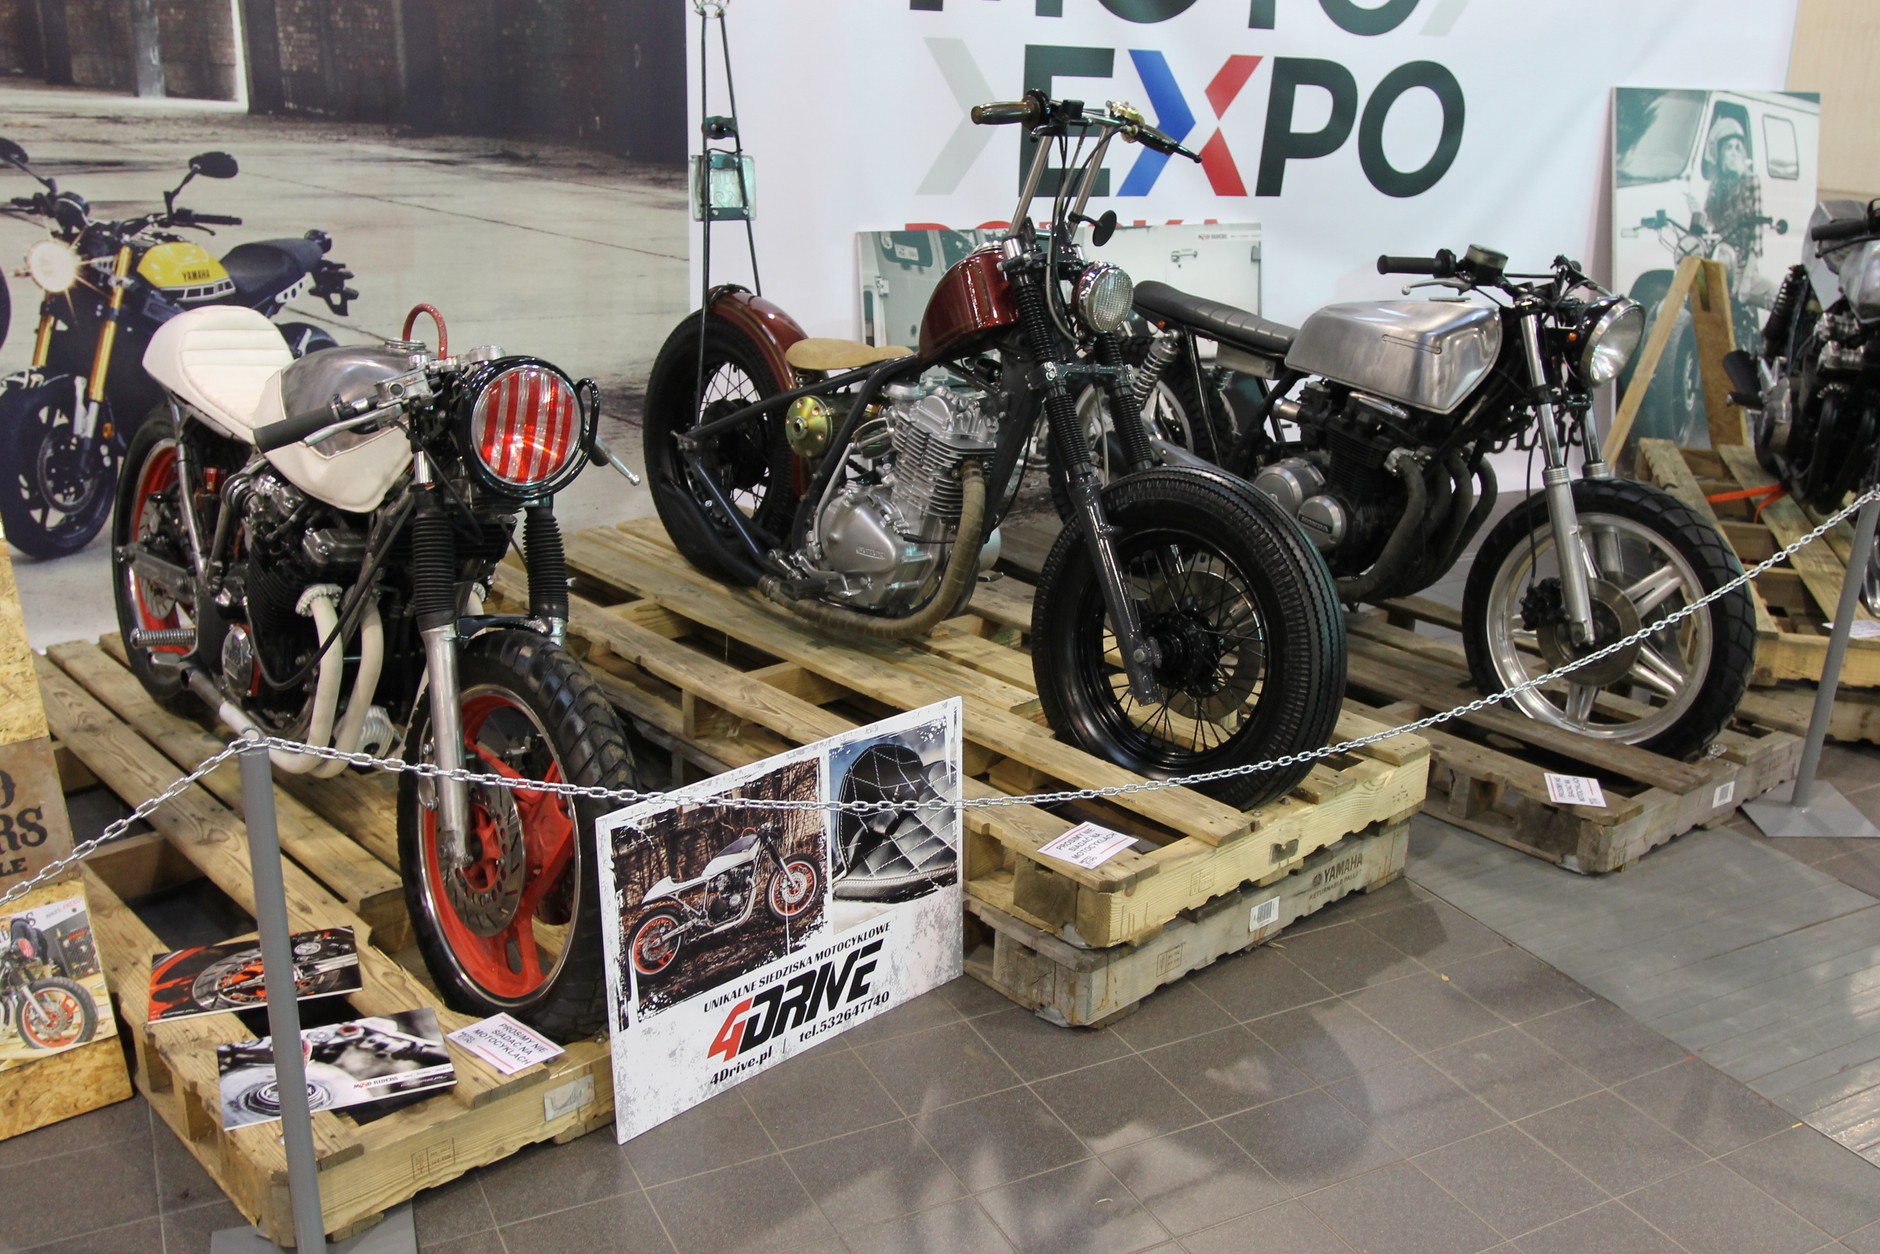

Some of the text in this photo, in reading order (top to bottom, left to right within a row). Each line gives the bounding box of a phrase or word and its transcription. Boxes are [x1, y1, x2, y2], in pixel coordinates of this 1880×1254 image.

[1018, 44, 1465, 198] EXPO
[181, 269, 210, 281] YAMAHA
[1324, 853, 1363, 882] YAMAHA
[704, 920, 891, 1013] UNIKALNE SIEDZISKA MOTOCYKLOWE
[707, 938, 884, 1063] 4DRIVE
[473, 1028, 532, 1065] MOTOCYKLACH
[499, 1022, 548, 1053] PROSIMY NIE
[521, 1045, 533, 1055] NA
[709, 991, 890, 1086] 4Drive.pl tel.532647740
